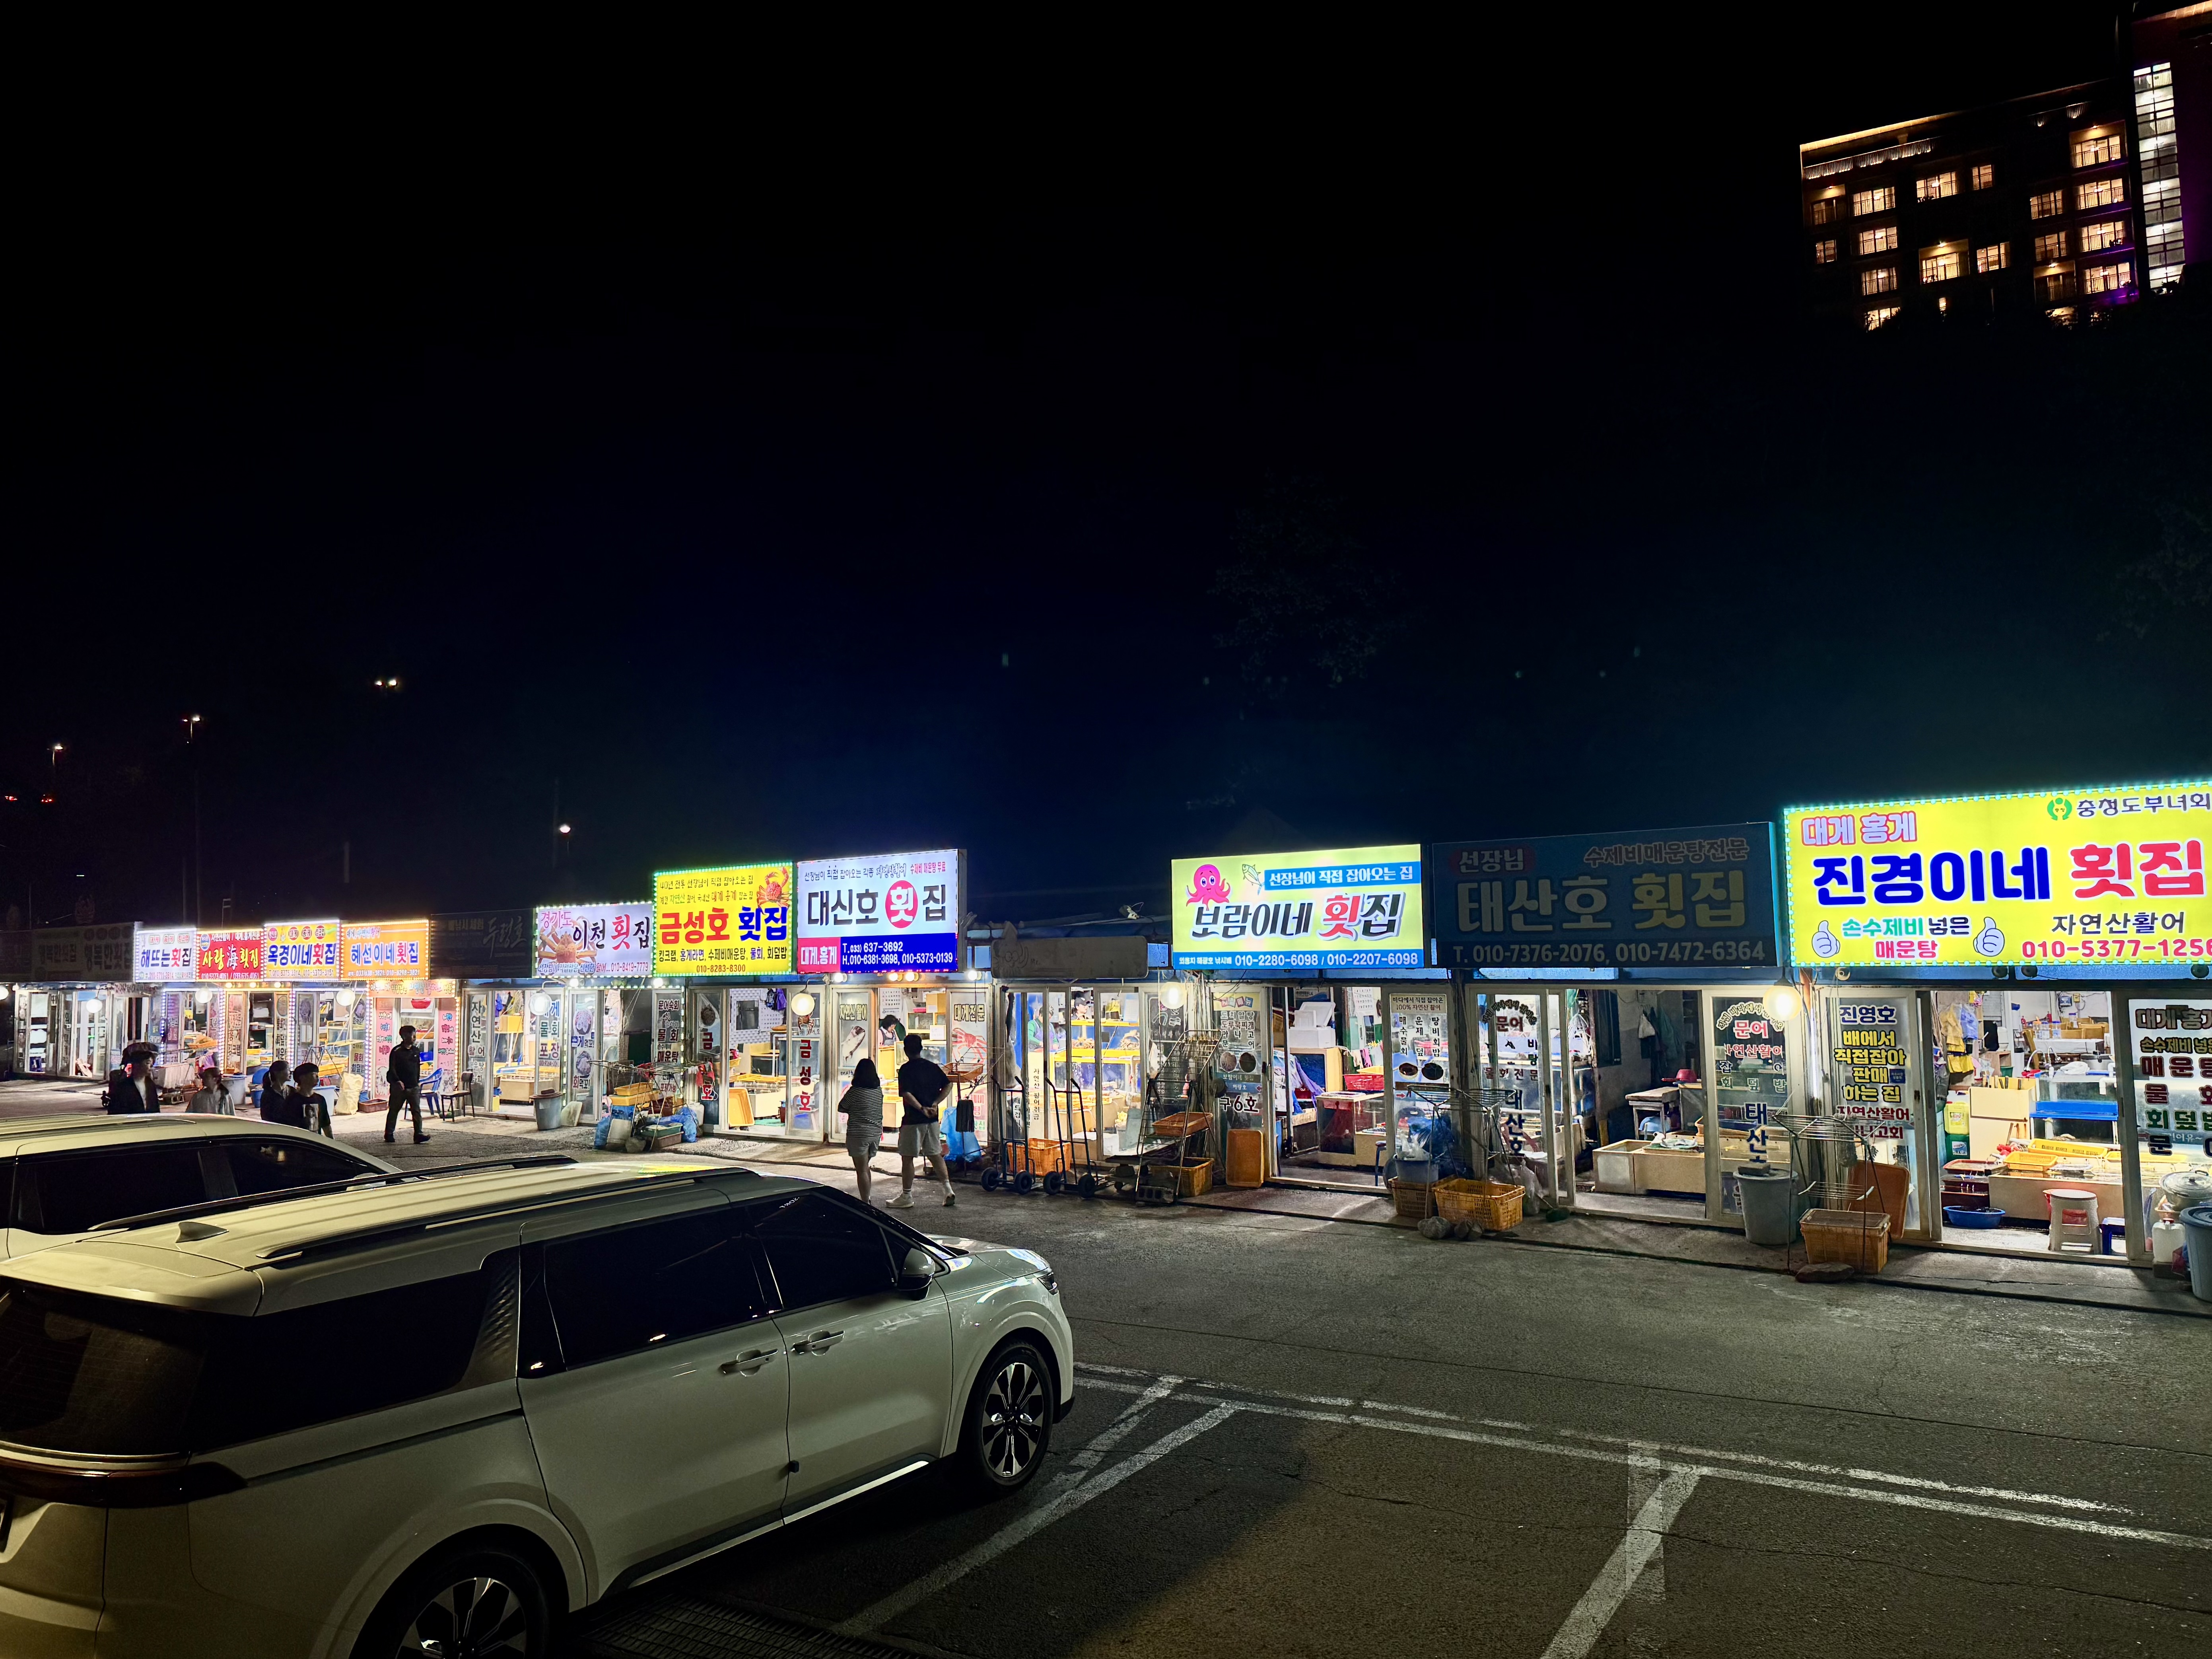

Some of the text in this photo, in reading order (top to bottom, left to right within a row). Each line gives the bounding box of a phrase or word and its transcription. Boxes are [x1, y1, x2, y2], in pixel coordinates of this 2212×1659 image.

[2077, 793, 2210, 817] 충청도부녀회
[1801, 811, 1917, 846] 대게 홍게
[1458, 837, 1749, 873] 선장님 수제비매운탕전문
[805, 871, 825, 881] 선장님이
[827, 869, 838, 880] 직접
[840, 869, 861, 879] 잡아오는
[863, 868, 874, 878] 각종
[1269, 865, 1413, 886] 선장님이 직접 잡아오는 집
[1813, 840, 2204, 905] 진경이네 횟집
[660, 881, 673, 889] 40년
[687, 878, 708, 888] 선장님이
[711, 877, 721, 886] 직접
[724, 876, 746, 886] 잡아오는
[748, 875, 753, 884] 집
[670, 893, 685, 904] 자연산
[711, 891, 723, 902] 대게
[725, 890, 737, 901] 홍게
[808, 884, 946, 926] 대신호 횟집
[1457, 870, 1746, 932] 태산호 횟집
[541, 911, 572, 928] 경기도
[1192, 893, 1402, 938] 보람이네 횟집
[2051, 912, 2184, 935] 자연산활어
[573, 914, 650, 950] 이천 횟집
[660, 906, 787, 944] 금성호 횟집
[1842, 917, 1924, 937] 손수제비
[659, 950, 678, 962] 킹크랩,
[680, 949, 706, 962] 홍게라면,
[767, 946, 787, 959] 회덮밥
[863, 941, 903, 953] 637-3692
[1615, 940, 1765, 962] 010-7472-6364
[1876, 940, 1938, 959] 매운탕
[902, 952, 953, 964] 010-5373-0139
[1235, 955, 1318, 967] 010-2280-6098
[1327, 953, 1418, 966] 010-2207-6098
[611, 962, 649, 972] 010-8419-7779
[696, 964, 746, 973] 010-8283-8300
[658, 1000, 680, 1010] 문어숙회
[839, 1004, 867, 1021] 자연산 활어
[954, 1004, 985, 1022] 대게전문
[471, 1001, 482, 1043] 자연산
[1839, 1006, 1897, 1023] 진영호
[2135, 1008, 2178, 1030] 대게
[540, 1021, 560, 1038] 물회
[1497, 1016, 1523, 1032] 문어
[1734, 1021, 1768, 1038] 문어
[657, 1028, 679, 1041] 물회
[1843, 1031, 1896, 1046] 배에서
[468, 1046, 485, 1056] 활어
[539, 1042, 560, 1058] 포장
[2140, 1037, 2212, 1054] 손수제비 넣
[354, 1053, 363, 1062] 물회
[1834, 1049, 1906, 1065] 직접잡아
[799, 1039, 812, 1112] 금성호
[1852, 1067, 1888, 1083] 판매
[1843, 1085, 1901, 1103] 하는 집
[1854, 1125, 1903, 1139] 나고회
